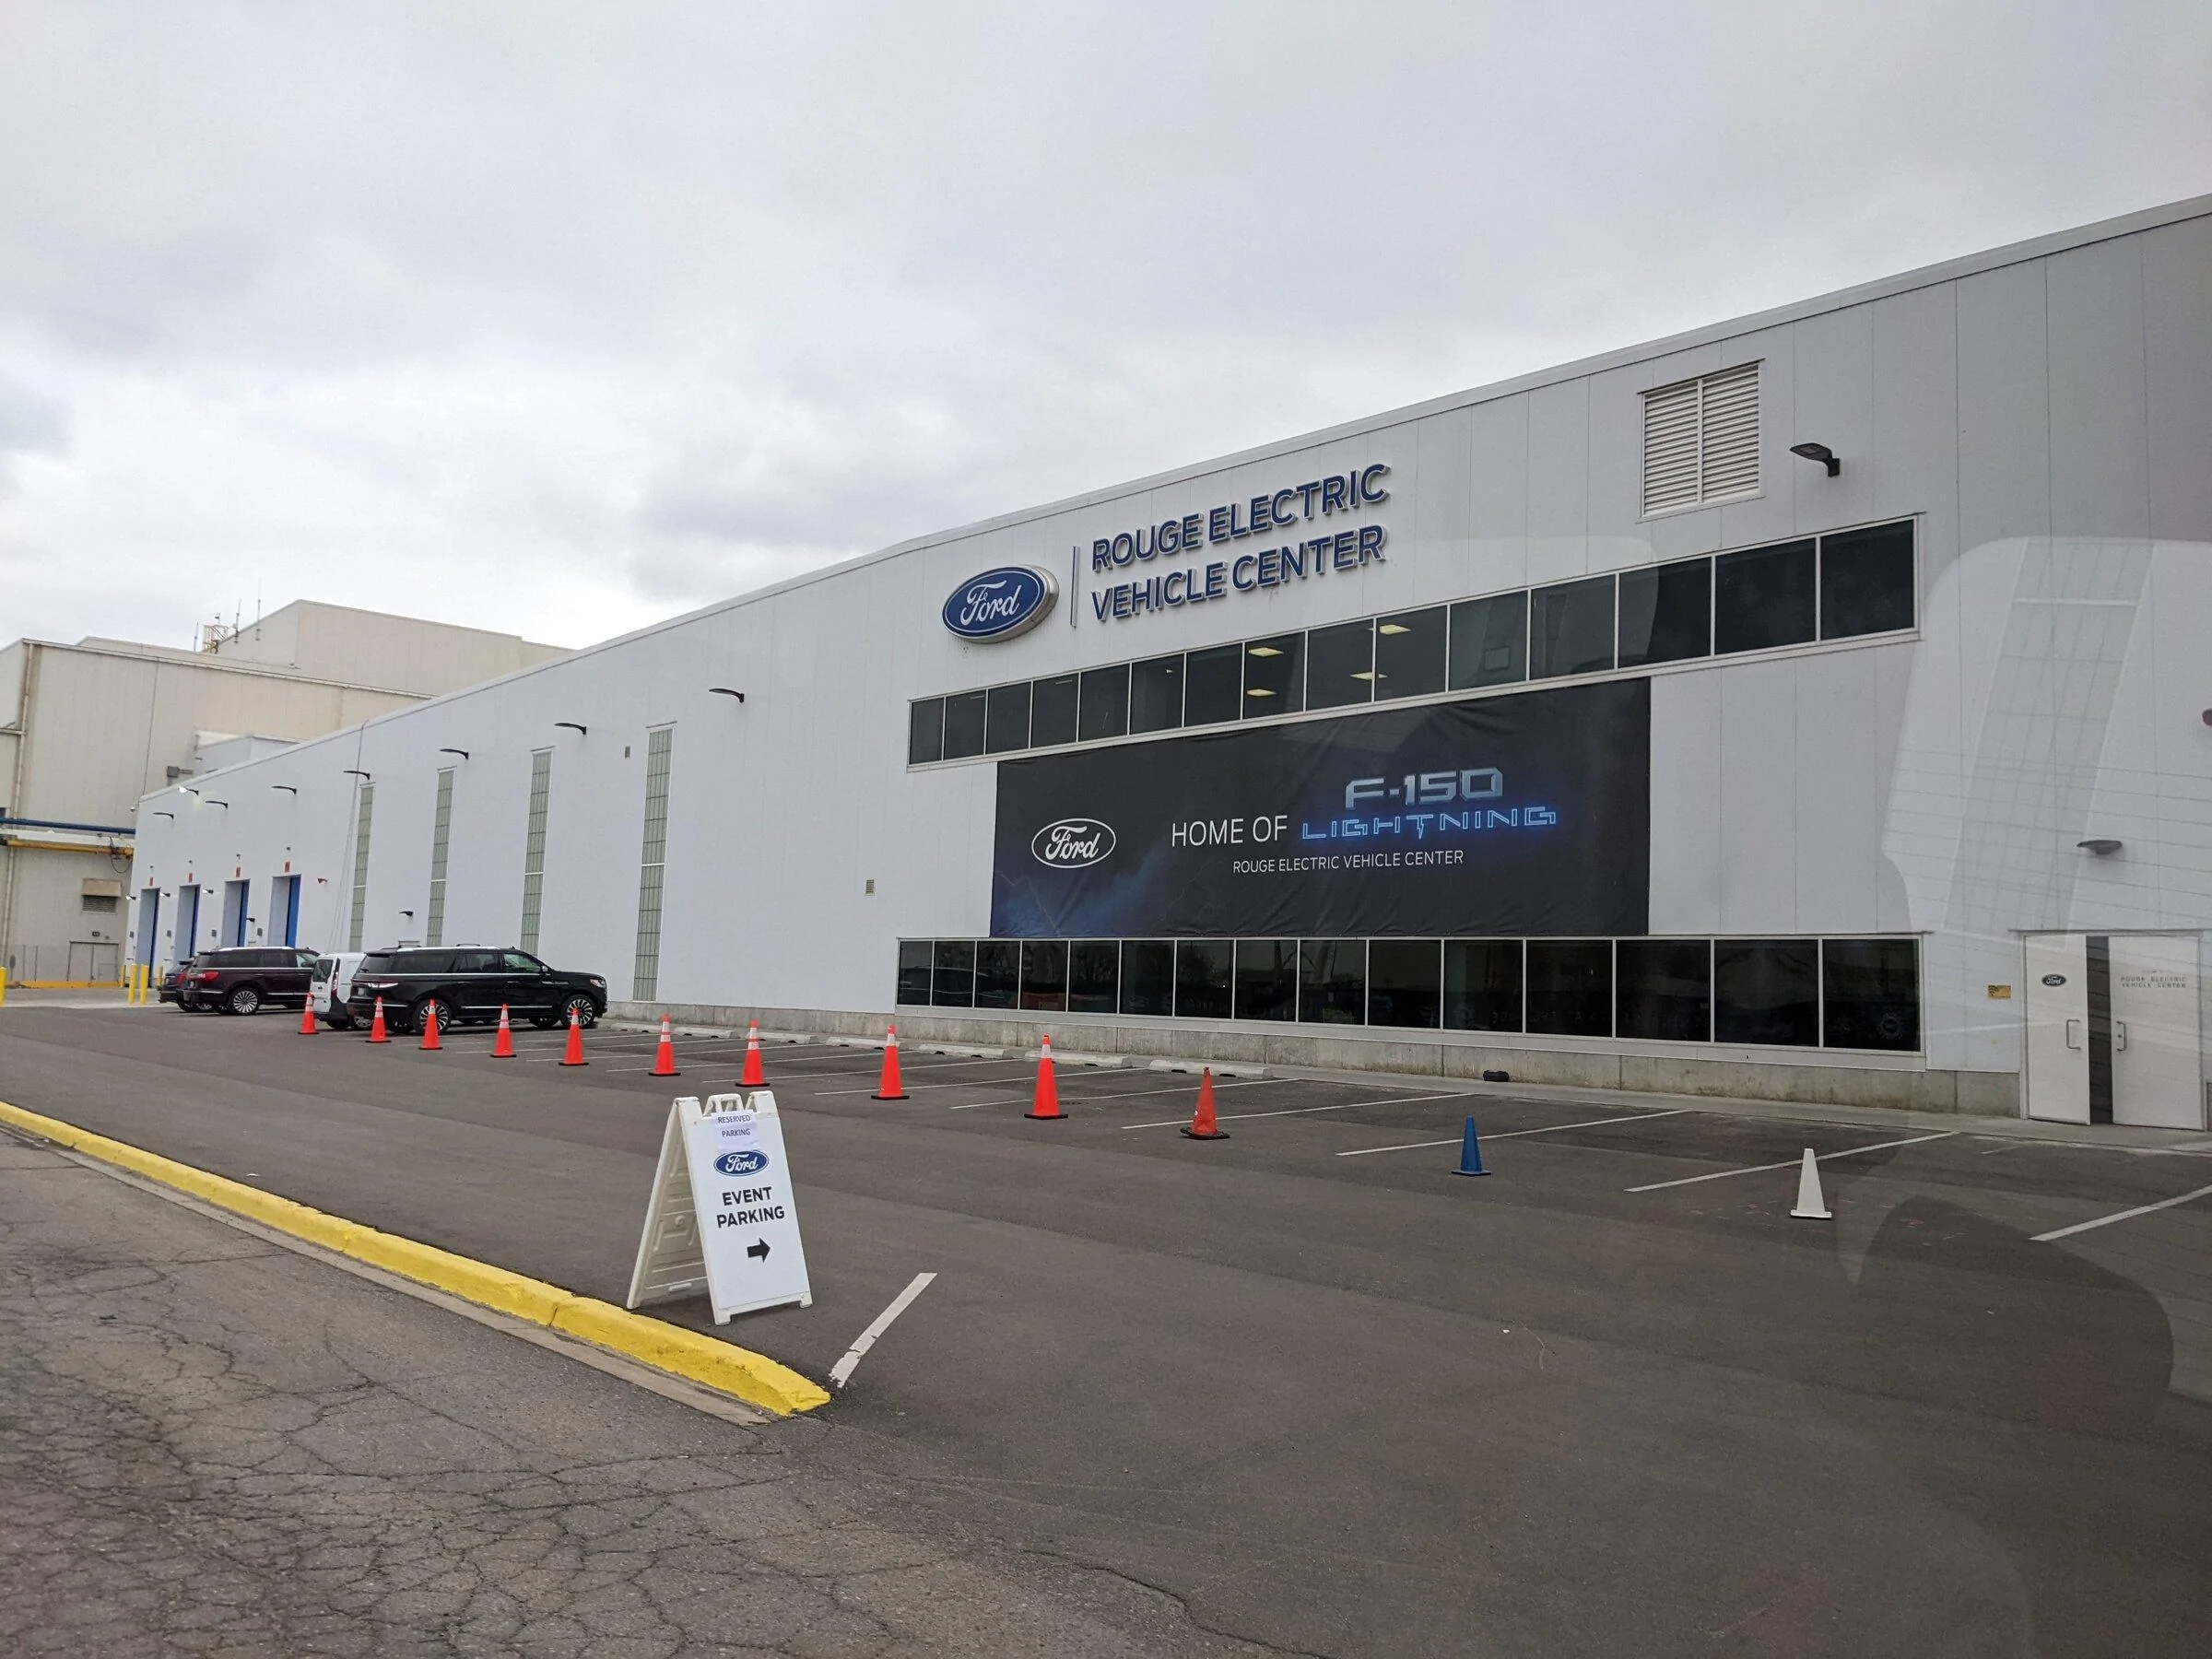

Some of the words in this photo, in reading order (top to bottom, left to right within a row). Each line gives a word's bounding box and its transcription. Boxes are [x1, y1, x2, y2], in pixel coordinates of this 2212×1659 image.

[1092, 512, 1203, 573] ROUGE
[1208, 463, 1390, 544] ELECTRIC
[1091, 560, 1228, 622] VEHICLE
[1232, 524, 1386, 592] CENTER
[959, 580, 1020, 626] Ford
[1345, 767, 1504, 810] F-150
[1171, 818, 1243, 847] HOME
[1253, 815, 1288, 842] OF
[1302, 806, 1557, 840] LIGHTNING
[1045, 825, 1101, 860] Ford
[1233, 859, 1275, 874] ROUGE
[1278, 855, 1339, 872] ELECTRIC
[1344, 853, 1401, 869] VEHICLE
[1405, 850, 1465, 866] CENTER
[718, 1114, 751, 1124] RESERVED
[722, 1128, 751, 1137] PARKING
[726, 1154, 759, 1172] Ford
[722, 1186, 772, 1206] EVENT
[716, 1206, 785, 1228] PARKING
